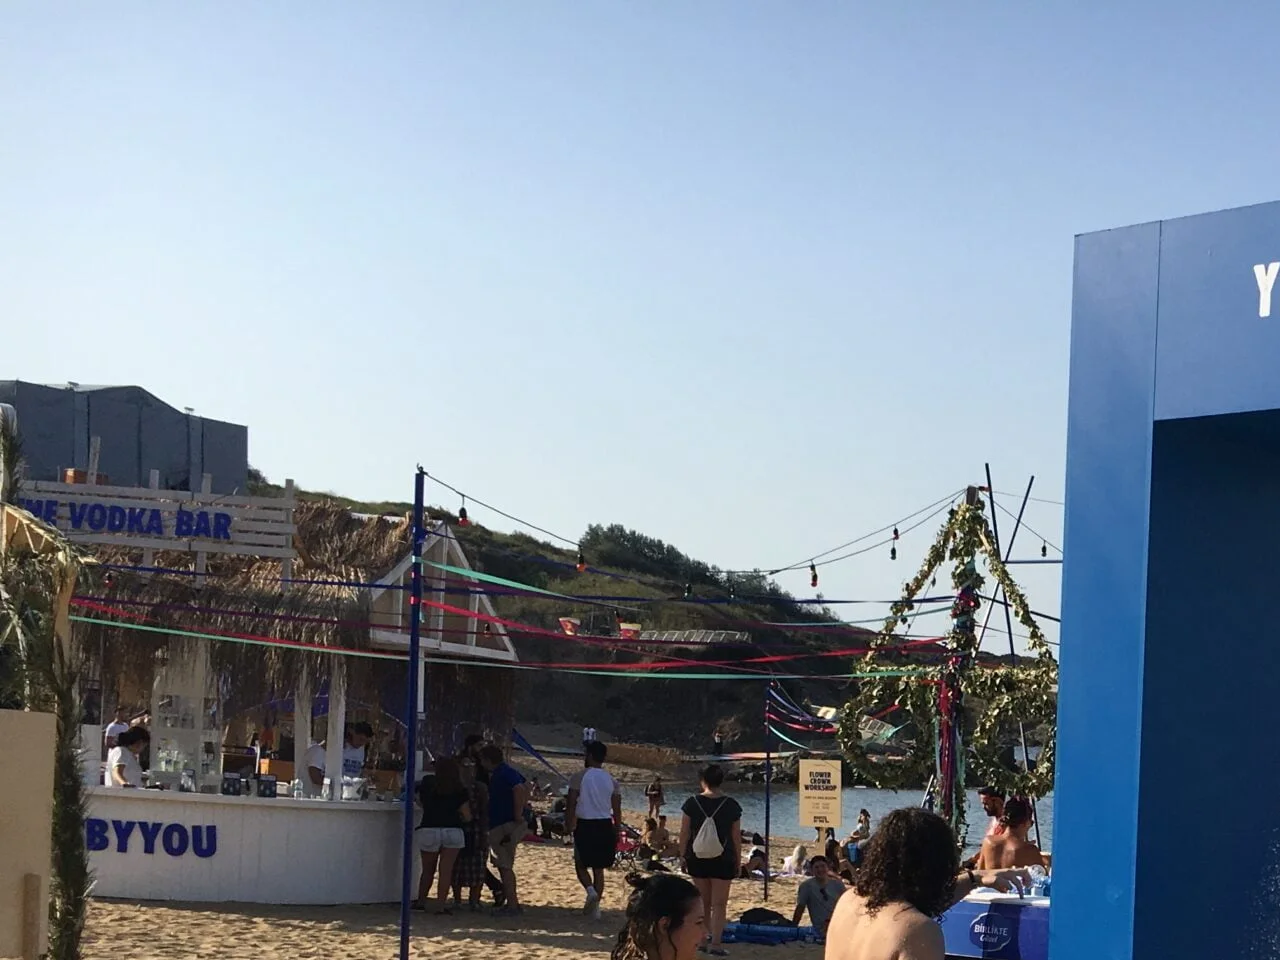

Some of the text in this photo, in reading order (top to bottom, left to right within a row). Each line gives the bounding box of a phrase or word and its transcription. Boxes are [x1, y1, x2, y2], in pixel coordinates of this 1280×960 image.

[69, 501, 164, 536] VODKA
[174, 510, 233, 541] BAR
[85, 818, 217, 858] BYYOU
